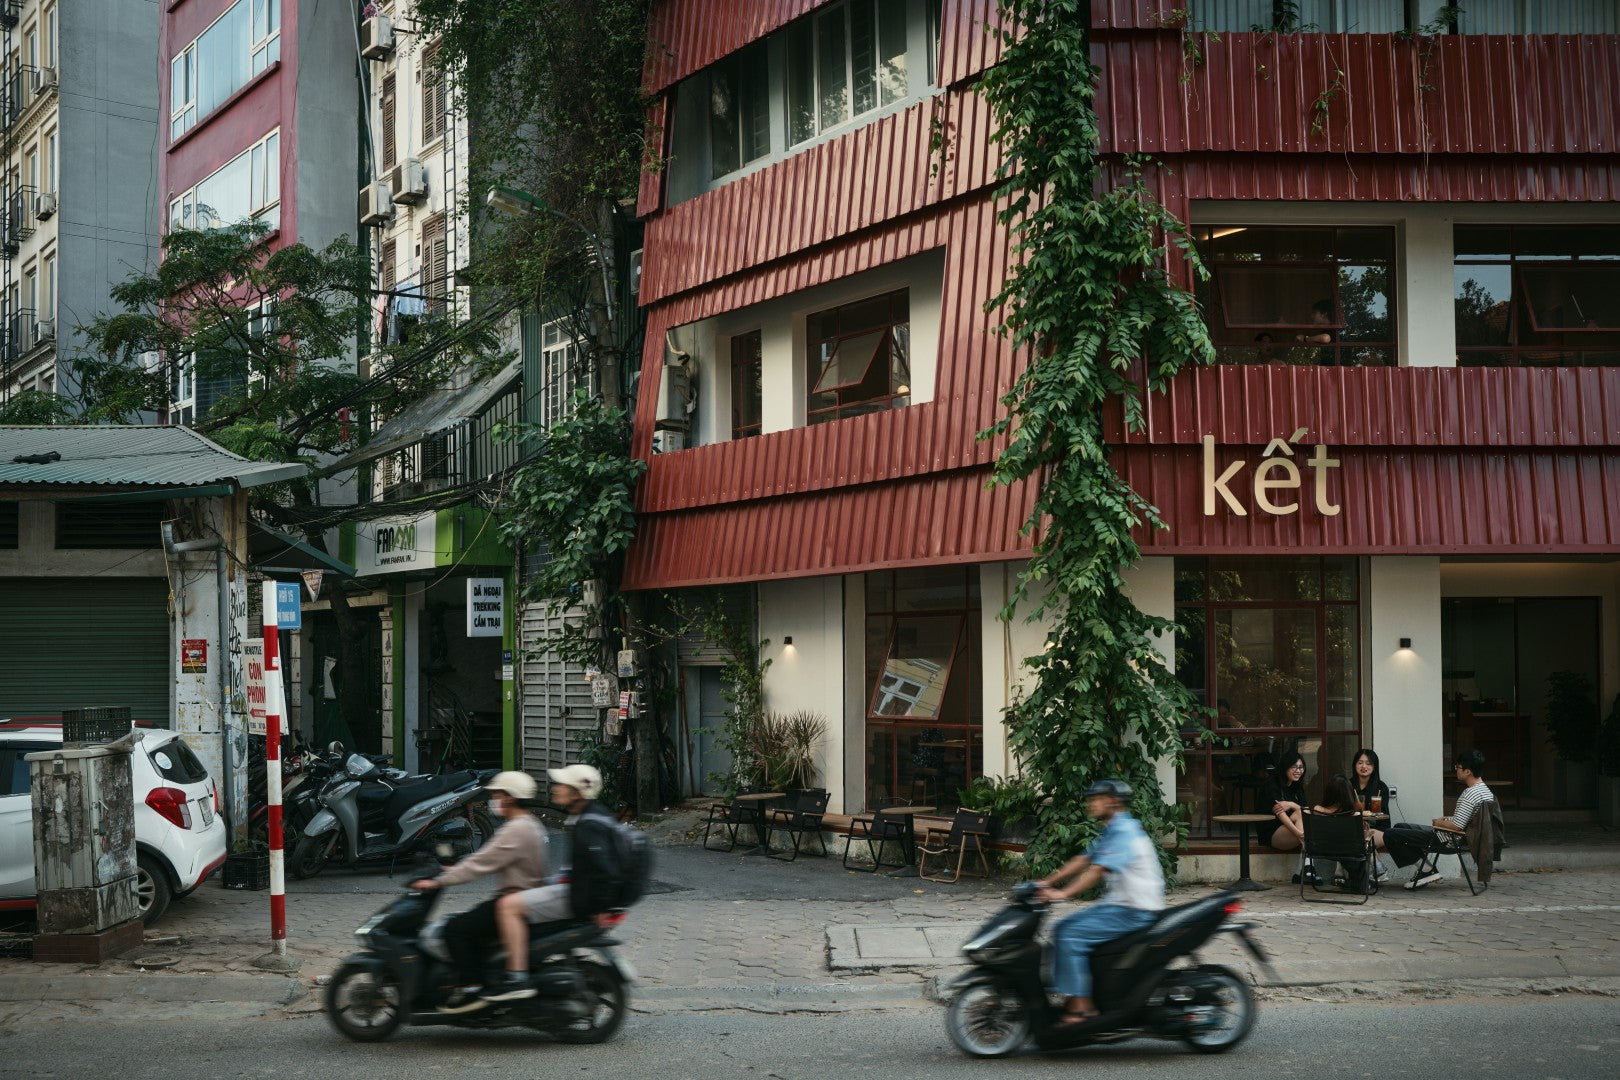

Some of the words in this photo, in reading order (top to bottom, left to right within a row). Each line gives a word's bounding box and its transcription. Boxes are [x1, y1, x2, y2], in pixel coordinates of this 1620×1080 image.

[1203, 427, 1341, 516] kết
[473, 602, 501, 612] TREKKING
[247, 682, 266, 704] PHÒN
